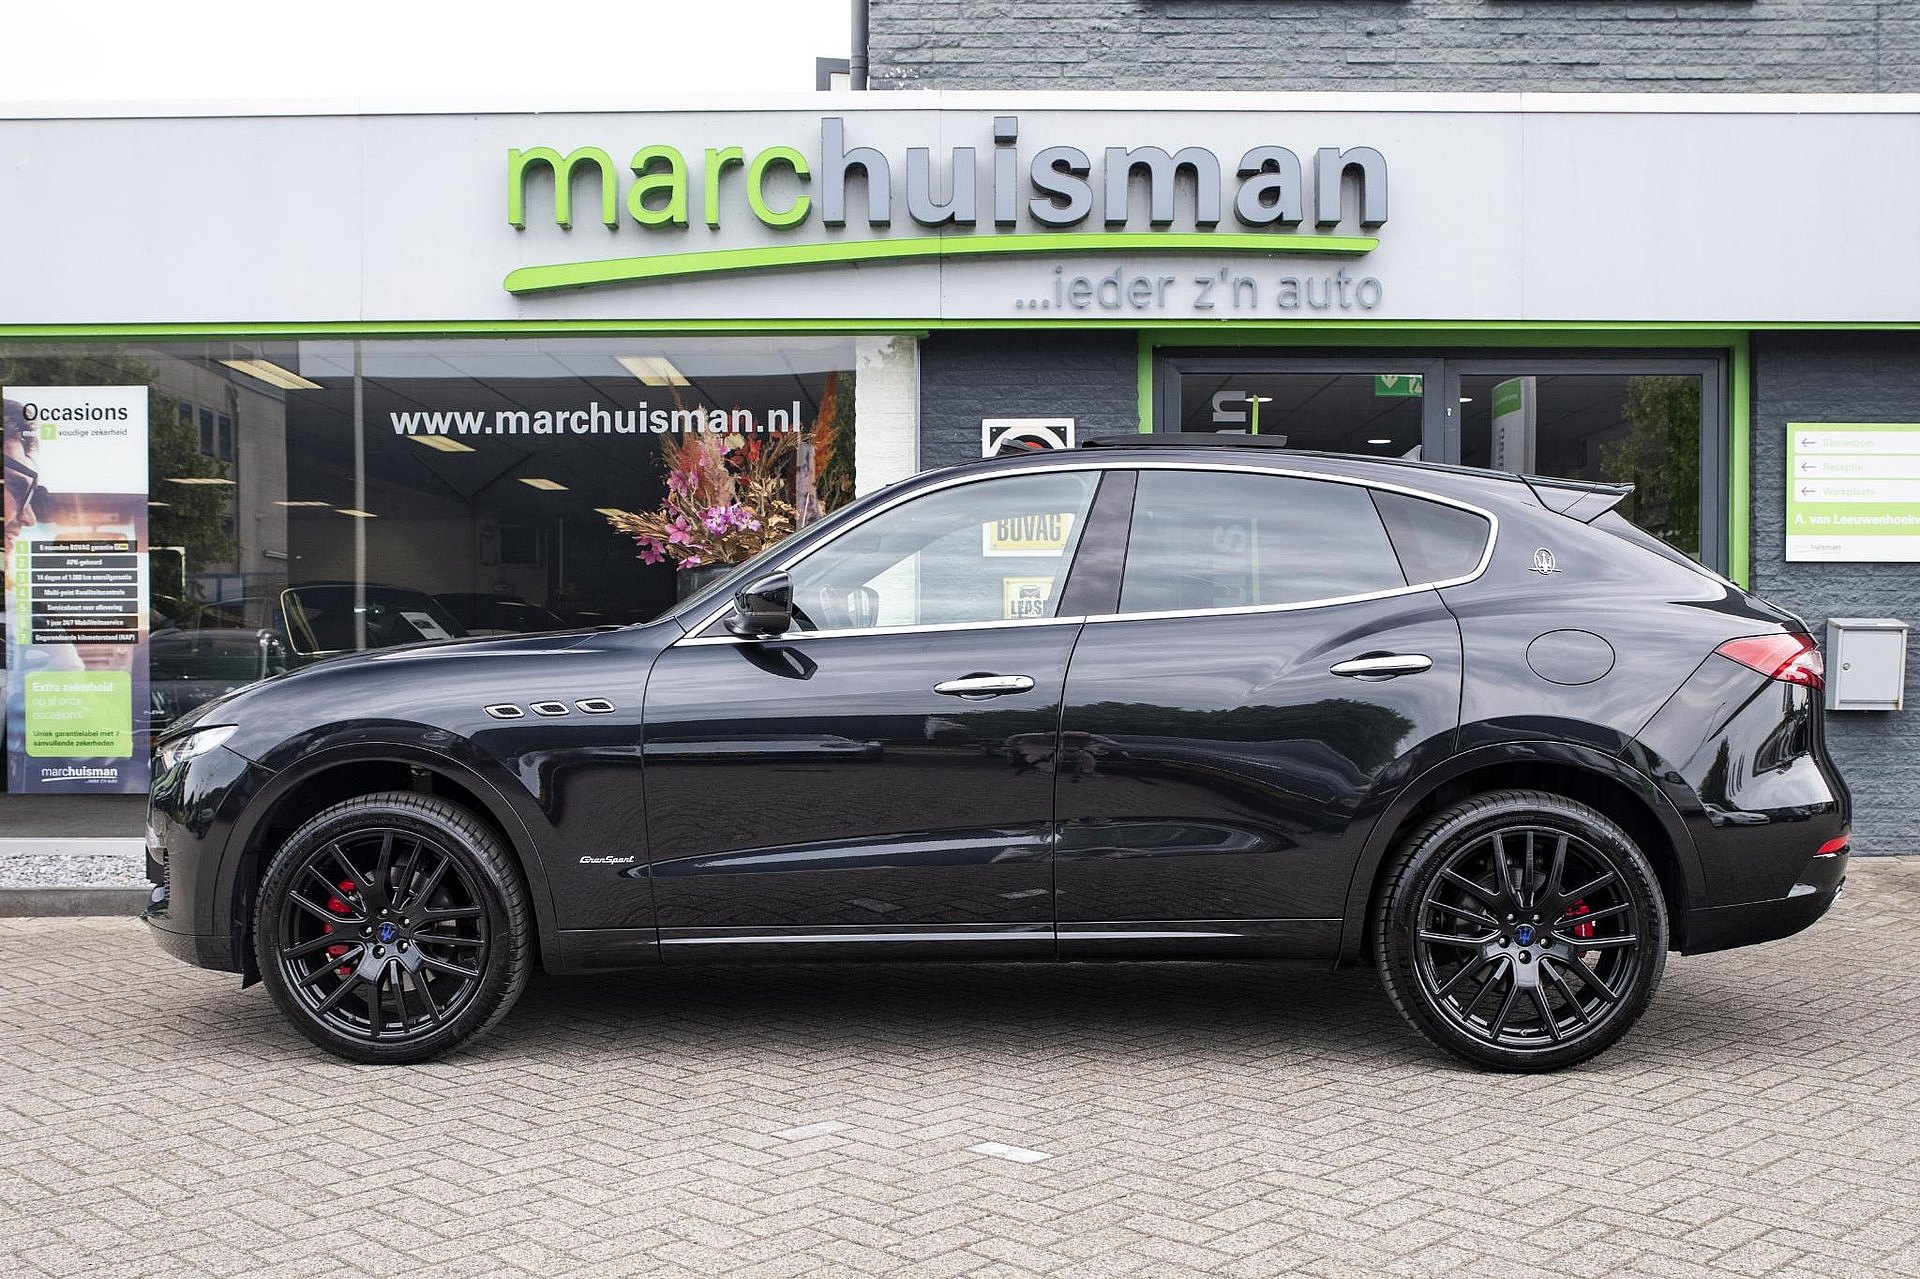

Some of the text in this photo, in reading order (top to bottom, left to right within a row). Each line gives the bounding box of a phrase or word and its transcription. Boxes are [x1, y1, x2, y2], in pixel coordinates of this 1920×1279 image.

[506, 116, 1389, 231] marchuisman
[1194, 267, 1259, 310] z'n
[1278, 270, 1384, 310] auto
[22, 402, 129, 422] Occasions
[390, 401, 801, 435] www.marchuisman.nl
[58, 428, 89, 437] voudige
[90, 428, 128, 437] zekerheid
[1809, 515, 1831, 525] van
[997, 513, 1062, 541] BOVAG
[1011, 600, 1043, 615] LEAS
[32, 681, 113, 692] Extra zekerheid
[54, 730, 99, 739] garantielabel
[41, 766, 118, 777] marchuisman
[579, 855, 635, 866] GranSport
